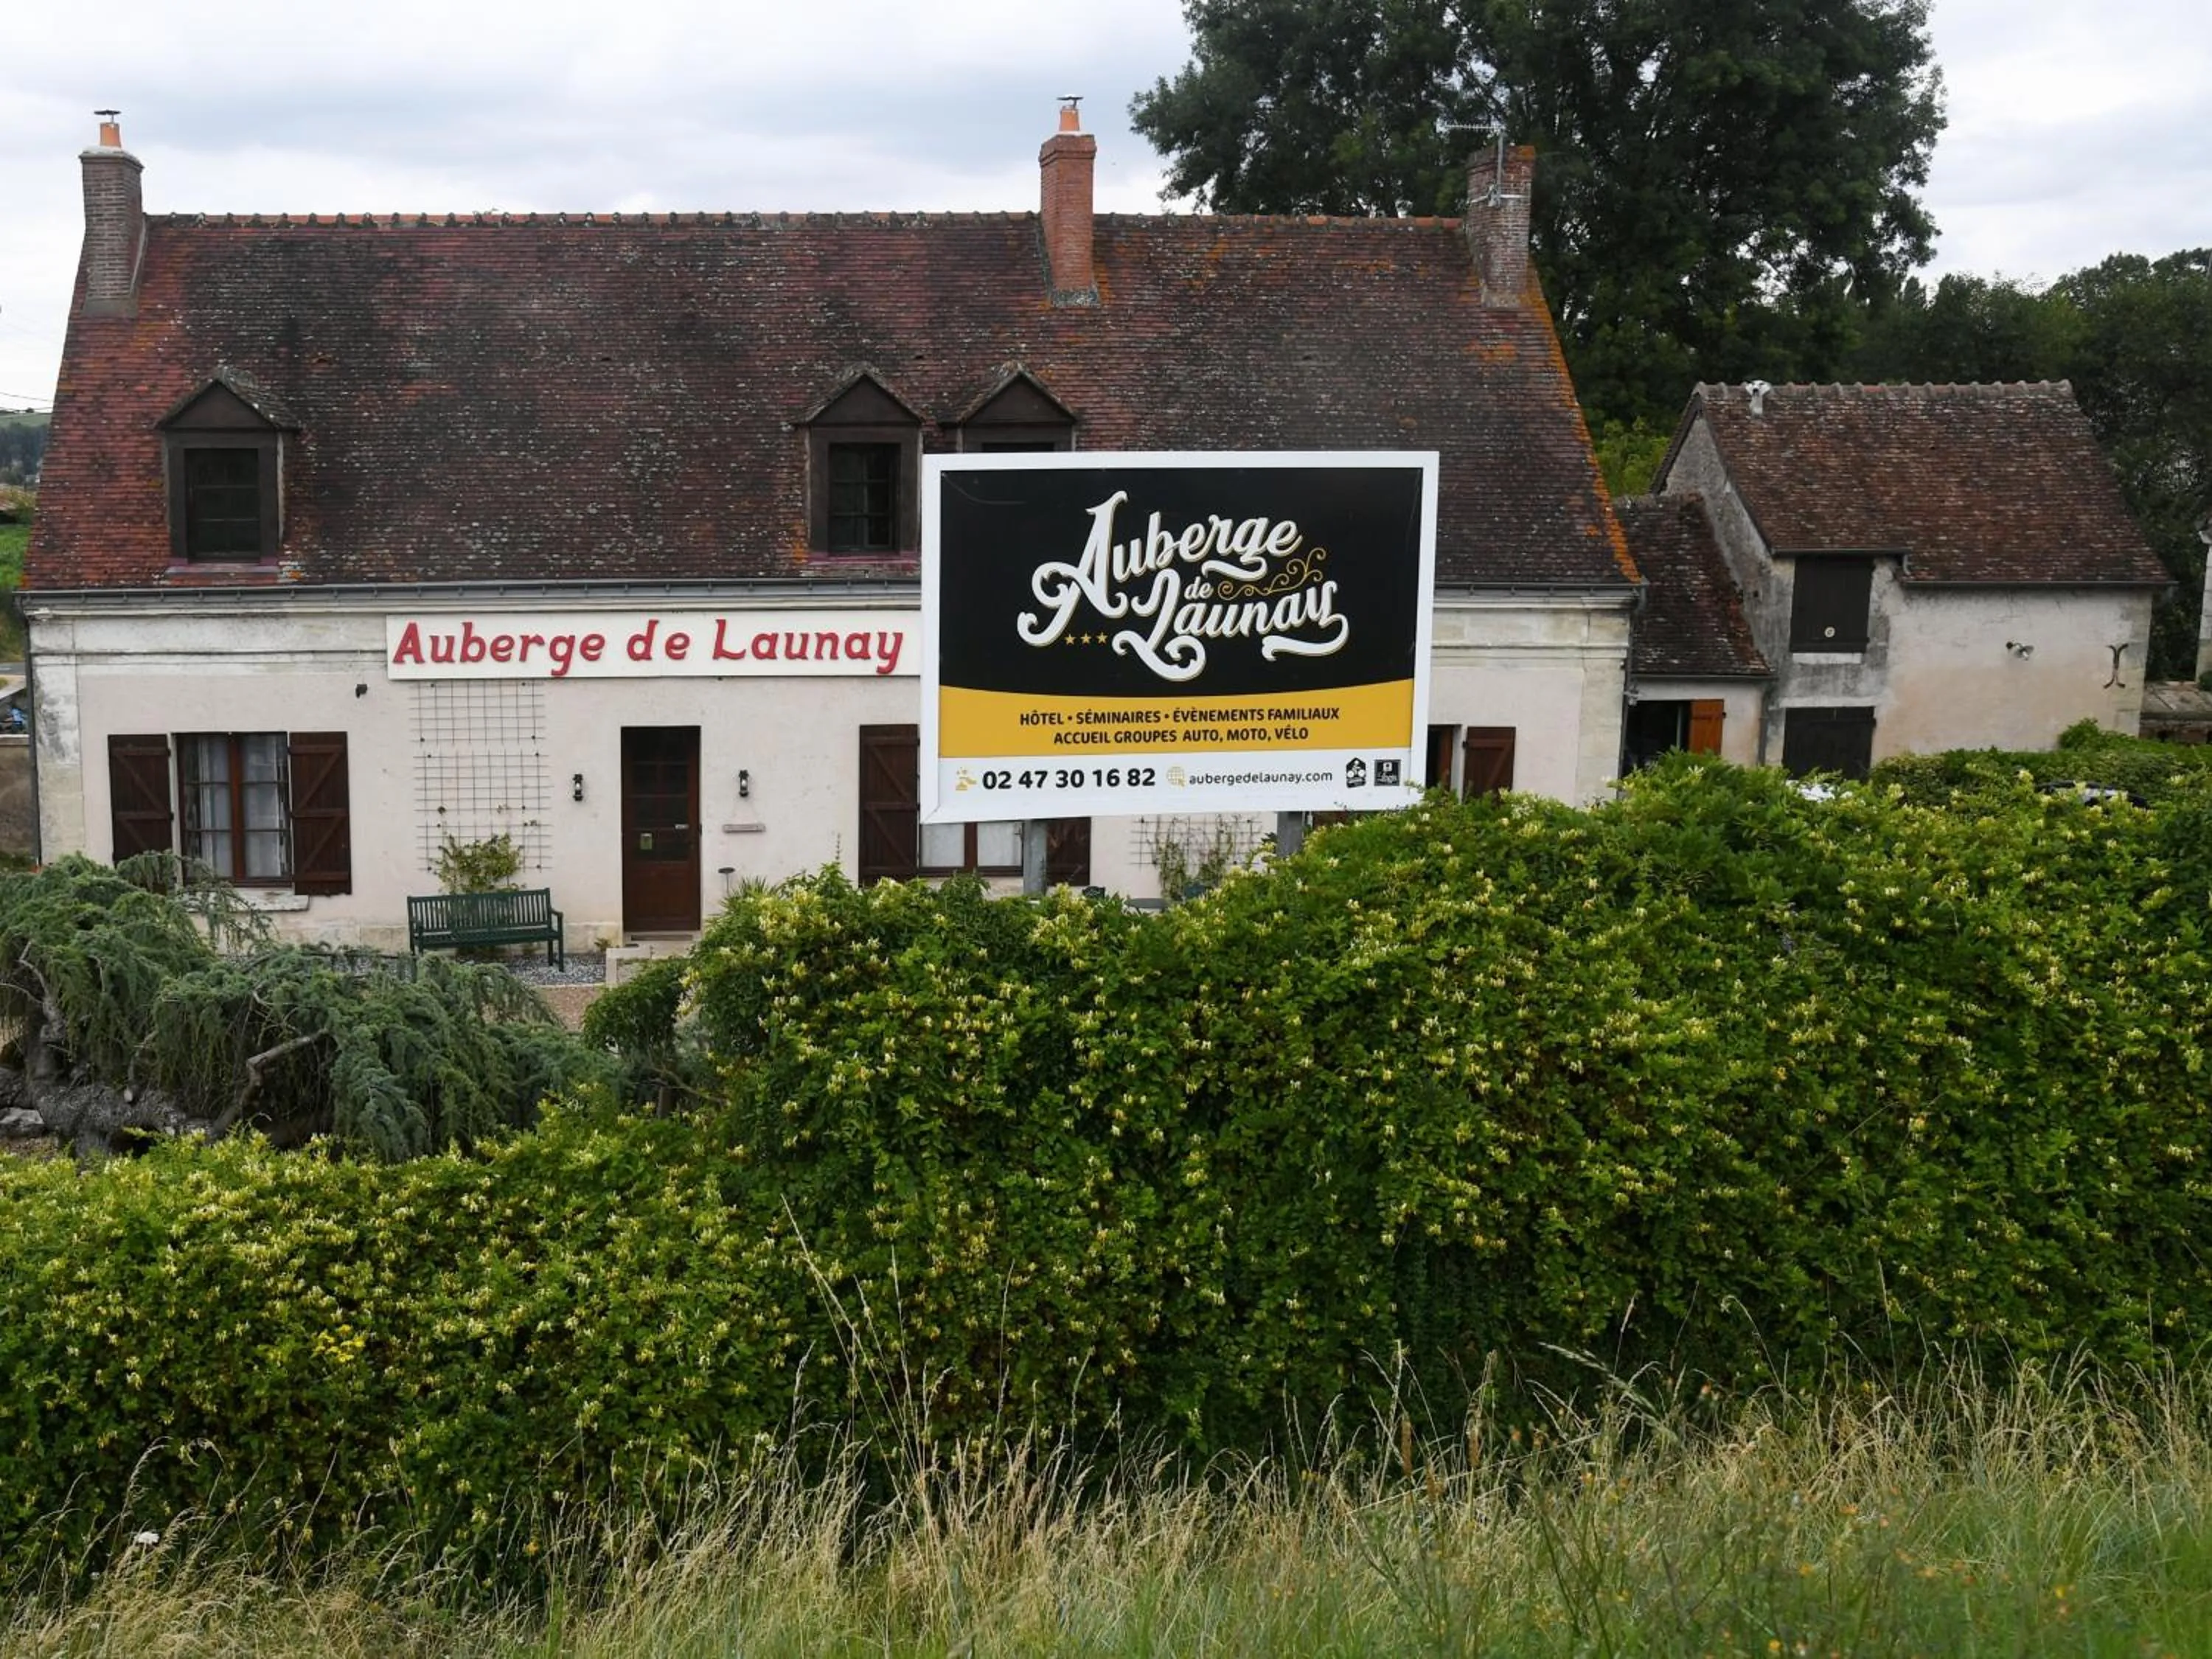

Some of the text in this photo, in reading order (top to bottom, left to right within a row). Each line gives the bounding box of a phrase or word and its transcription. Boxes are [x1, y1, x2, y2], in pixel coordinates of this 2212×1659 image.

[1017, 490, 1304, 647] Auberge
[1184, 579, 1213, 599] de
[1111, 568, 1349, 681] Launay
[392, 619, 903, 677] Auberge de Launay
[1020, 707, 1340, 726] HÔTEL SÉMINAIRES ÉVÈNEMENTS FAMILIAUX
[1054, 724, 1309, 745] ACCUEIL GROUPES AUTO, MOTO, VÉLO
[982, 768, 1155, 790] 02 47 30 16 82
[1189, 771, 1333, 787] aubergedelaunay.com
